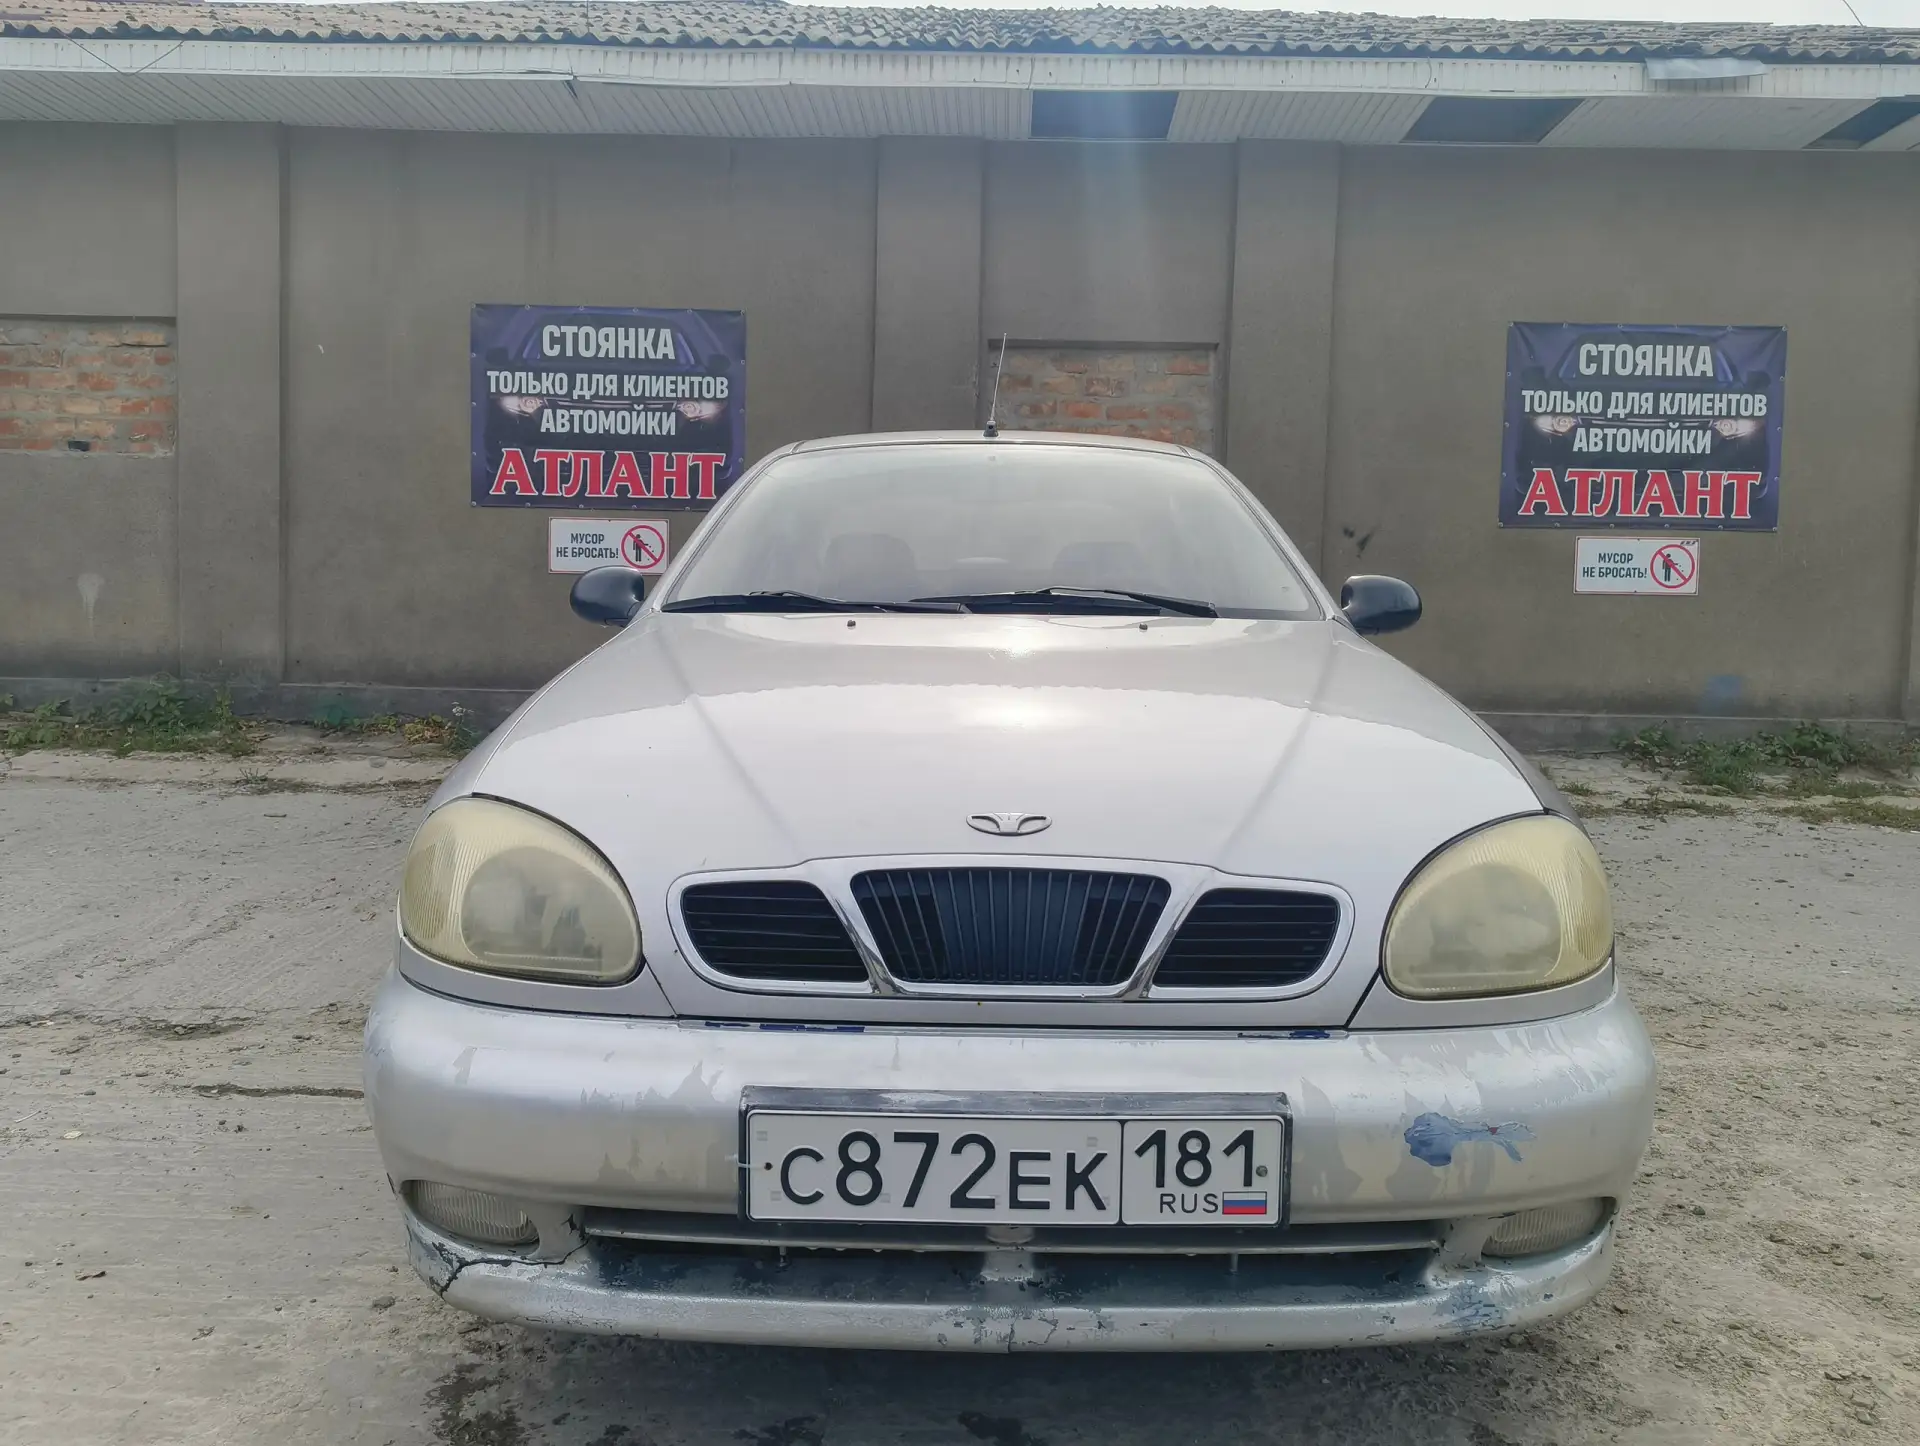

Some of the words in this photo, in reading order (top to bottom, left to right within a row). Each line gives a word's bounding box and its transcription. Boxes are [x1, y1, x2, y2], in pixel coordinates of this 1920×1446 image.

[542, 325, 675, 359] СТОЯНКА
[1578, 343, 1714, 377] СТОЯНКА
[487, 371, 568, 395] ТОЛЬКО
[573, 373, 618, 399] ДЛЯ
[623, 375, 728, 398] КЛИЕНТОВ
[1522, 390, 1603, 414] ТОЛЬКО
[1607, 392, 1653, 418] ДЛЯ
[1659, 393, 1767, 417] КЛИЕНТОВ
[540, 404, 676, 435] АВТОМОЙКИ
[1573, 422, 1712, 454] АВТОМОЙКИ
[489, 448, 726, 499] АТЛАНТ
[1517, 467, 1762, 518] АТЛАНТ
[556, 547, 569, 558] НЕ
[571, 547, 619, 559] БРОСАТЬ!
[570, 533, 605, 544] МУСОР
[1582, 567, 1595, 577] НЕ
[1598, 567, 1647, 579] БРОСАТЬ!
[1598, 553, 1634, 564] МУСОР
[1134, 1129, 1254, 1188] 181
[1159, 1193, 1219, 1214] RUS
